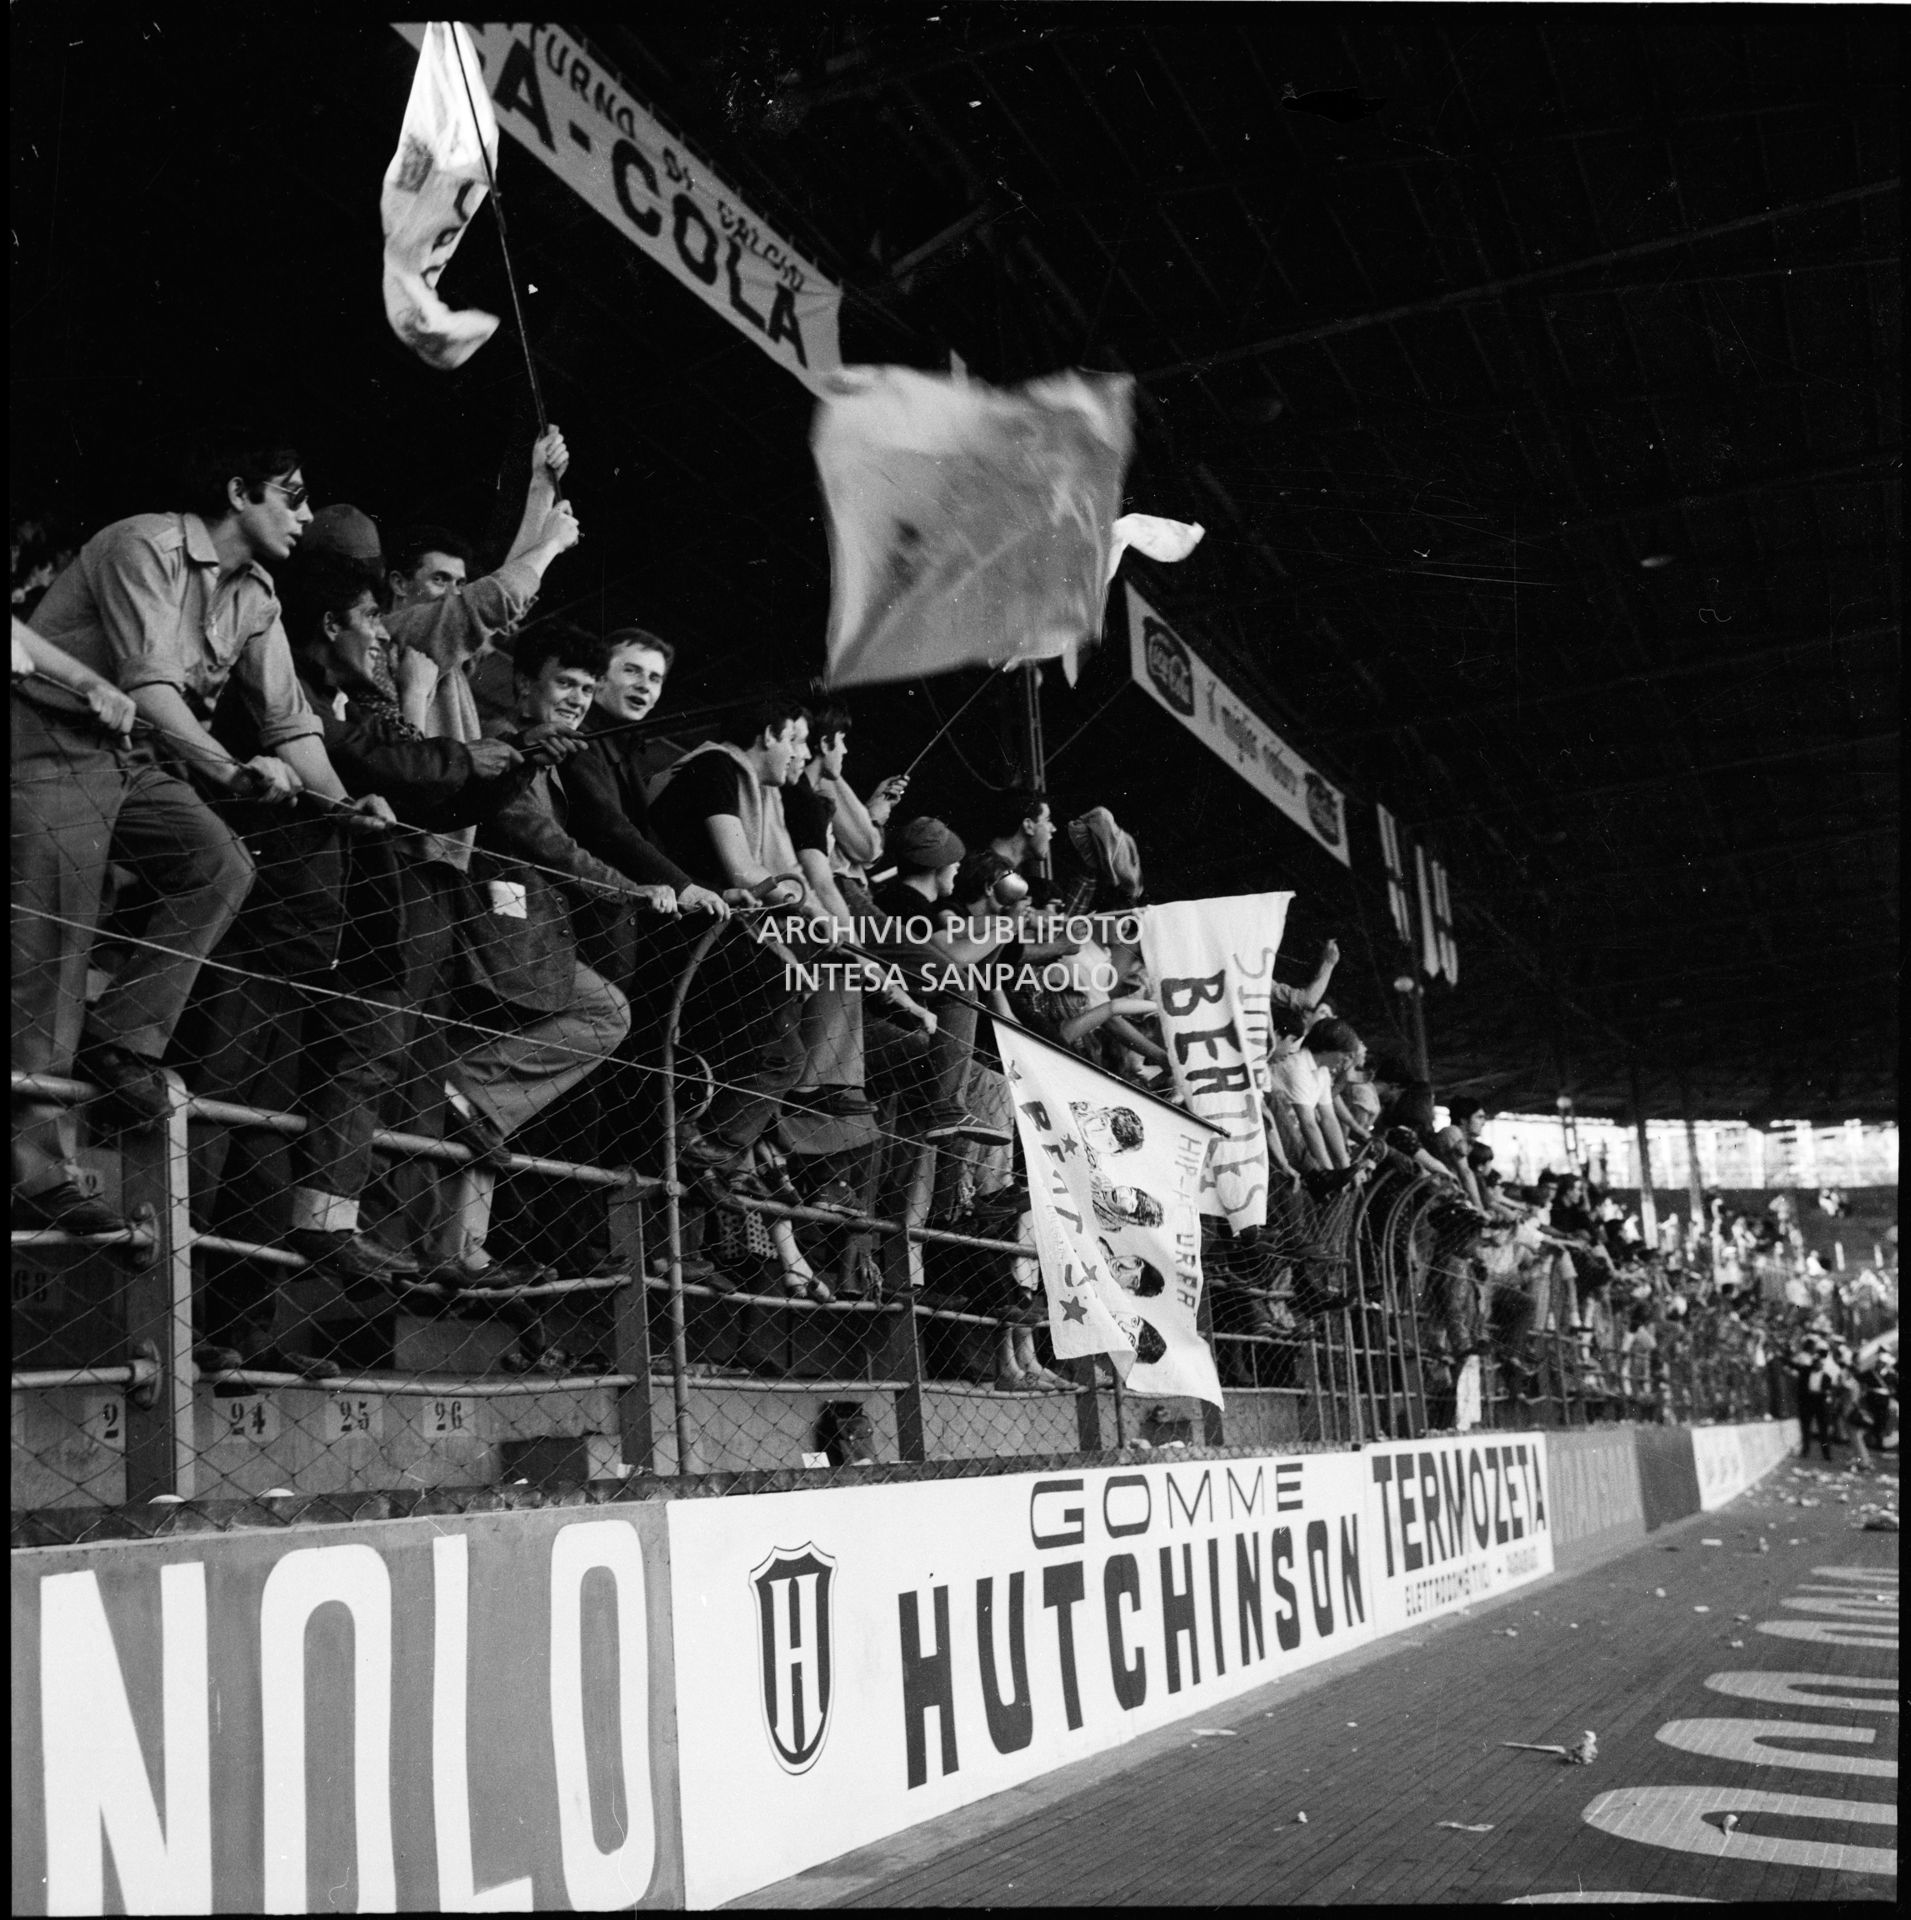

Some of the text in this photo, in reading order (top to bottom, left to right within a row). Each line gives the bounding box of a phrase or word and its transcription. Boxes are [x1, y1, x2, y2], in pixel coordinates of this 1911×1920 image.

[507, 23, 637, 141] TURNO
[474, 23, 808, 369] A-COLA
[103, 1403, 119, 1439] 2
[230, 1402, 266, 1436] 24
[340, 1401, 369, 1432] 25
[434, 1400, 463, 1431] 26
[1030, 1462, 1304, 1550] GOMME
[1372, 1444, 1546, 1578] TERMOZETA
[897, 1513, 1366, 1791] HUTCHINSON
[40, 1520, 656, 1917] NOLO
